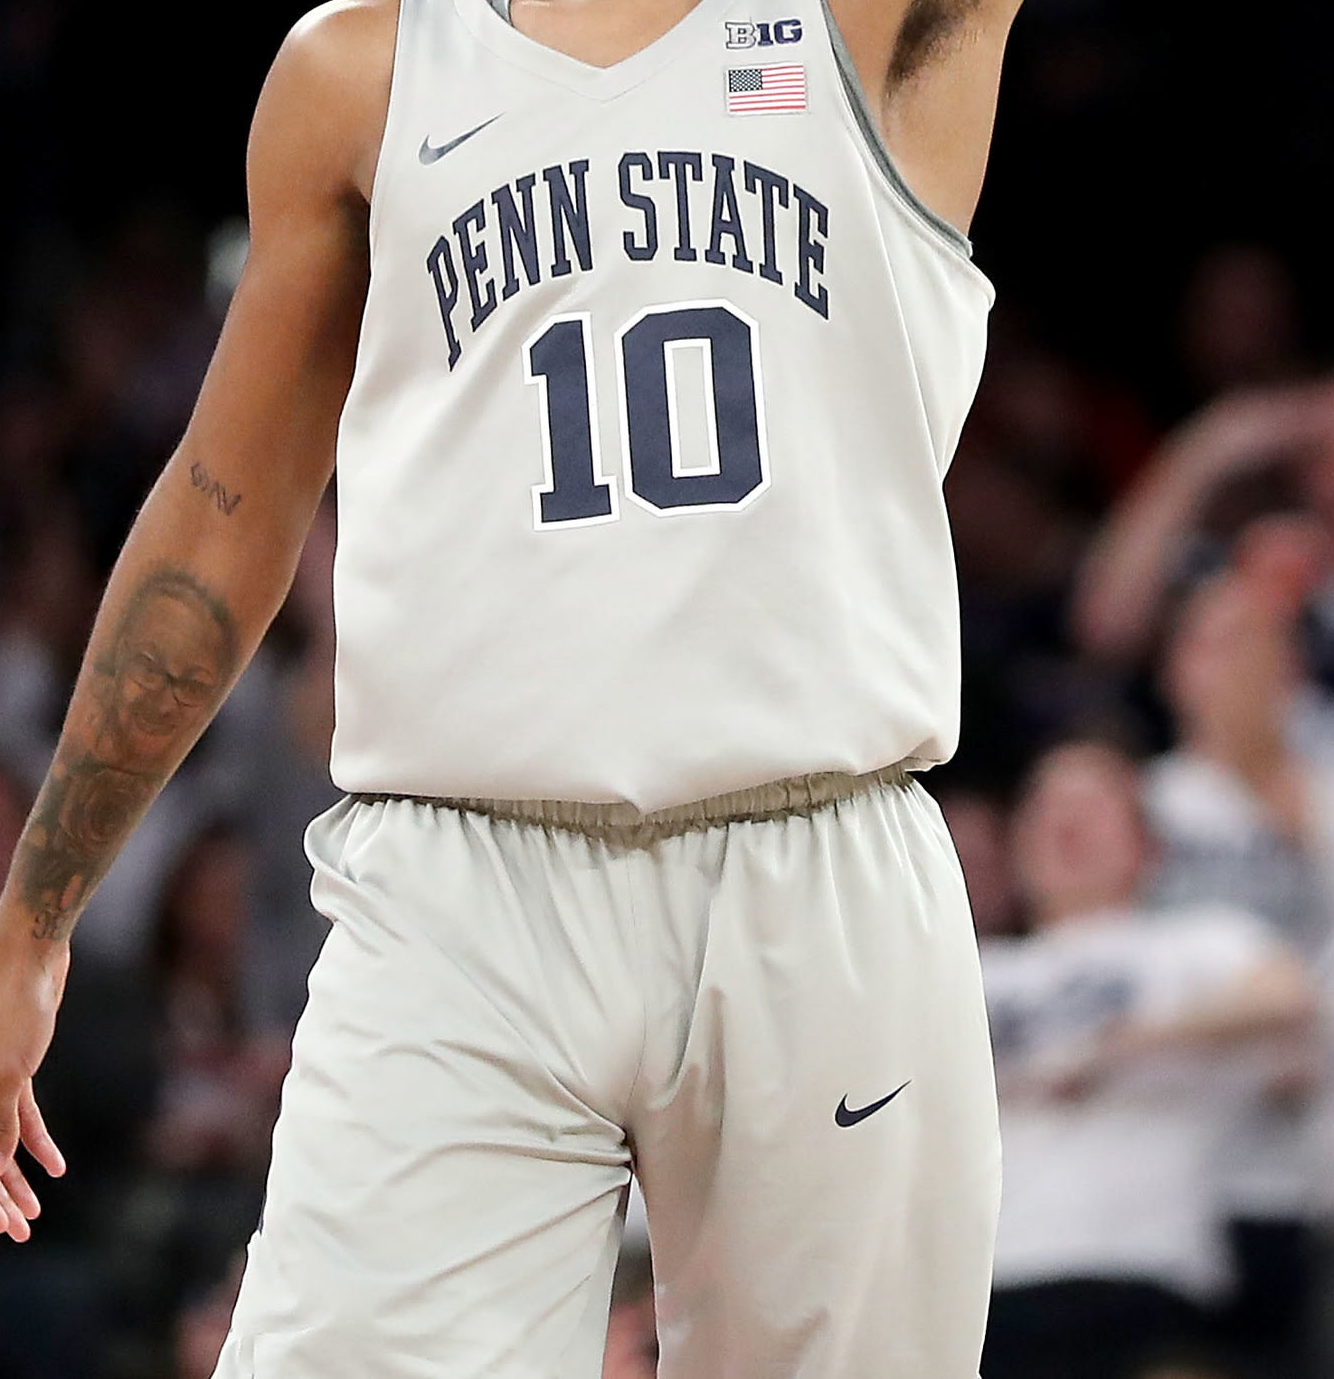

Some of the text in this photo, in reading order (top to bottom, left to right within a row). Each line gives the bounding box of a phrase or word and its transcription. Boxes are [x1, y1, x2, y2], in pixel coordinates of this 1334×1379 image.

[425, 150, 830, 373] PENN STATE
[521, 298, 772, 532] 10
